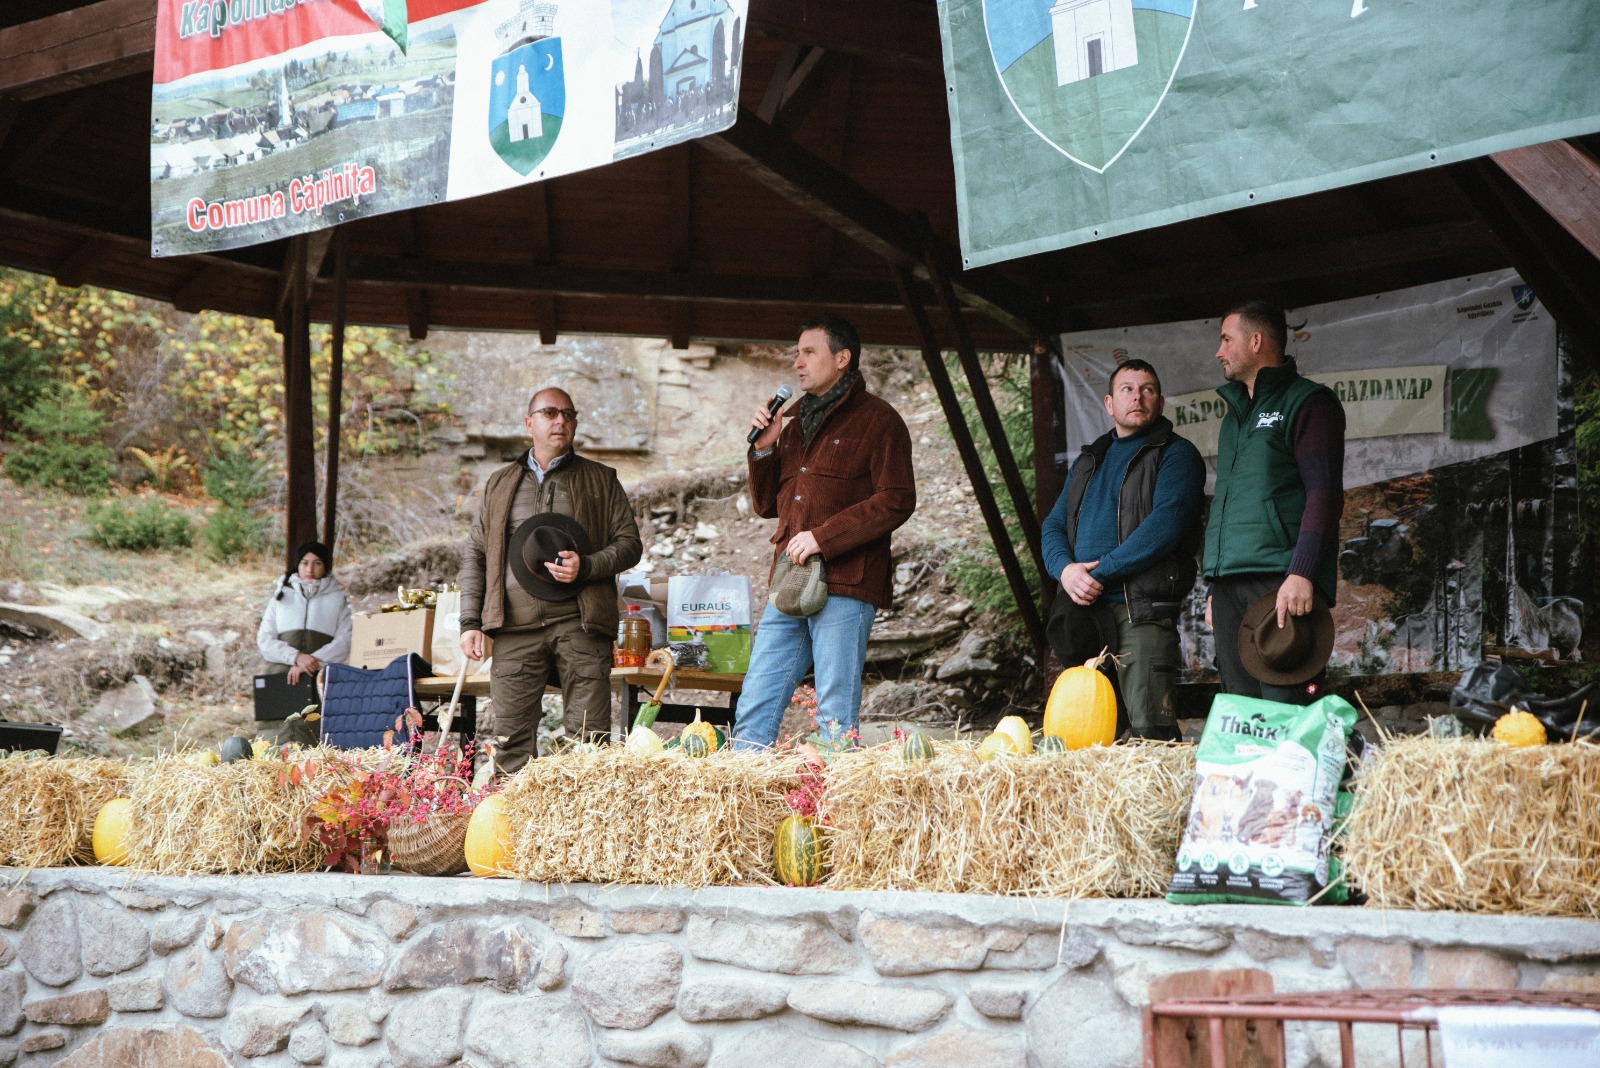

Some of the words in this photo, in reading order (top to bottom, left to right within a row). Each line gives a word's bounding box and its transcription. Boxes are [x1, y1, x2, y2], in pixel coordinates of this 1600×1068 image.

[187, 191, 285, 232] Comuna
[1175, 398, 1226, 427] KÁPO
[1333, 377, 1432, 402] GAZDANAP
[681, 601, 732, 612] EURALIS
[1220, 715, 1288, 741] Thank
